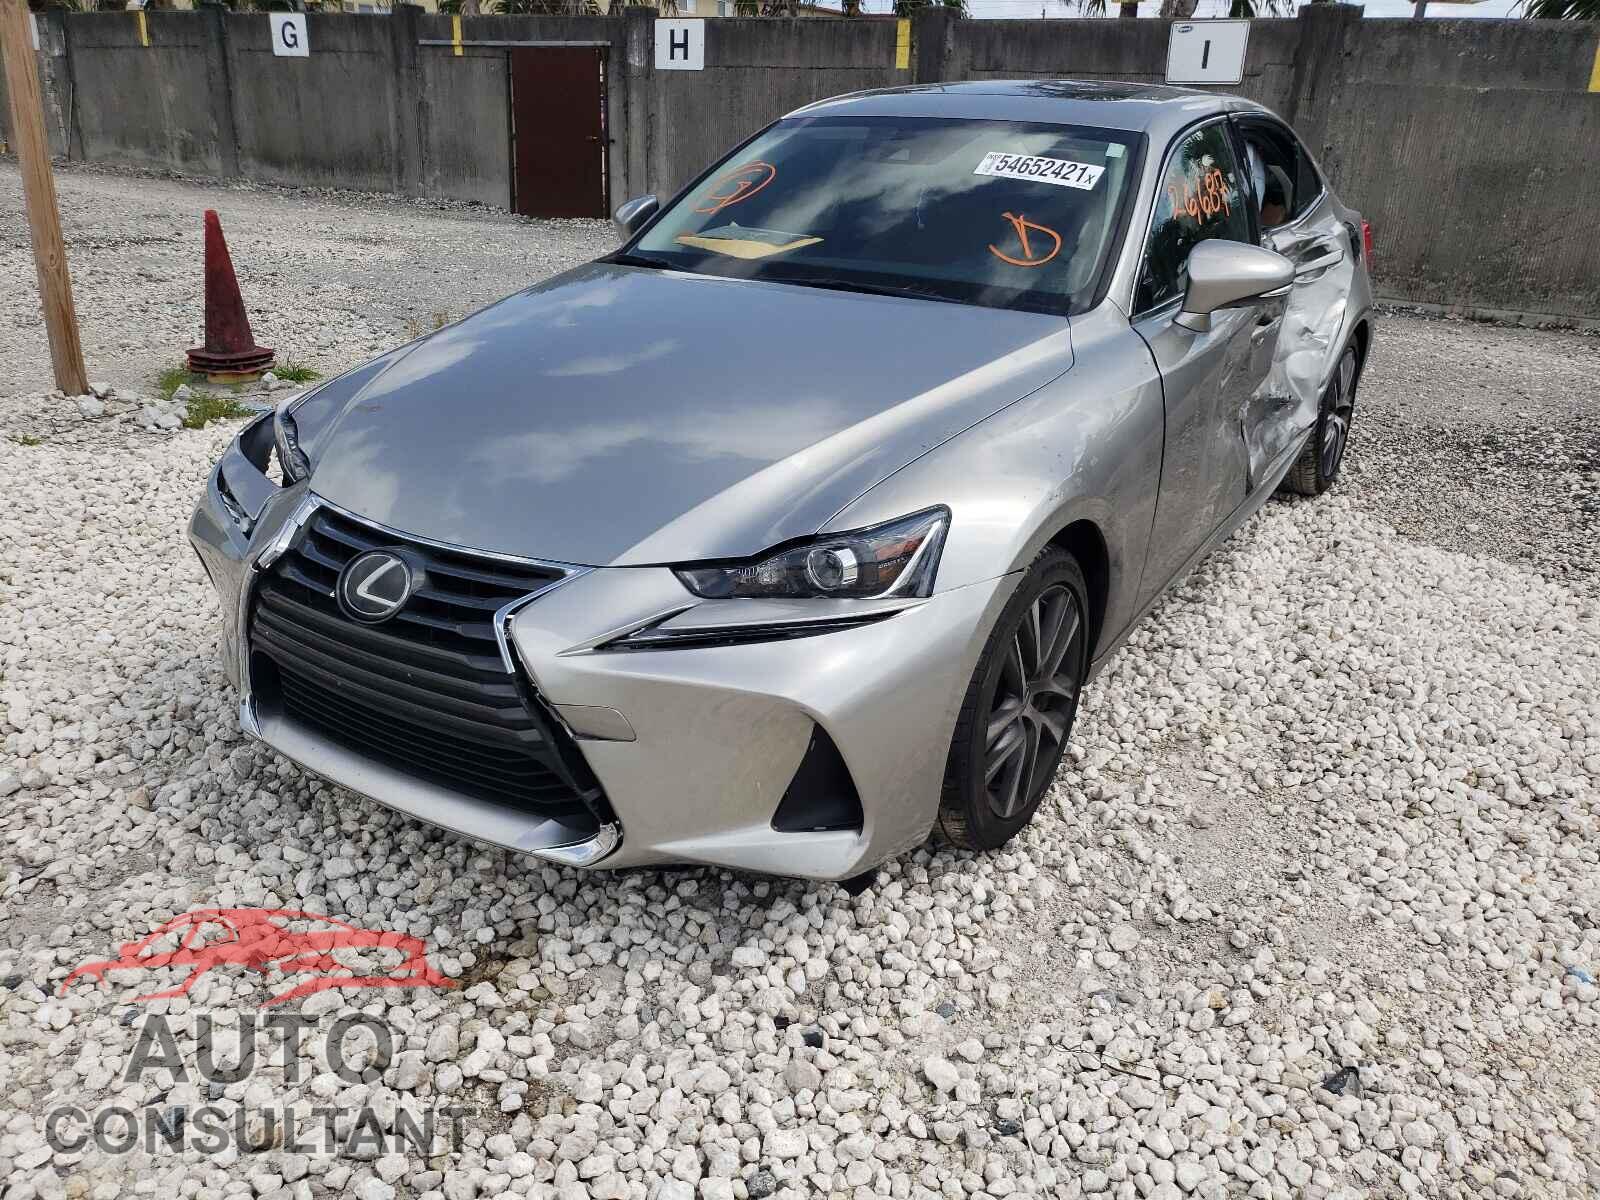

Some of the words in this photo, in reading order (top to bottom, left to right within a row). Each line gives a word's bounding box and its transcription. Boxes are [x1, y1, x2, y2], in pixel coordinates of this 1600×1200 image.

[281, 21, 299, 49] G
[669, 28, 689, 61] H
[1201, 39, 1211, 70] I
[995, 154, 1089, 182] 54652421
[988, 211, 1062, 266] D
